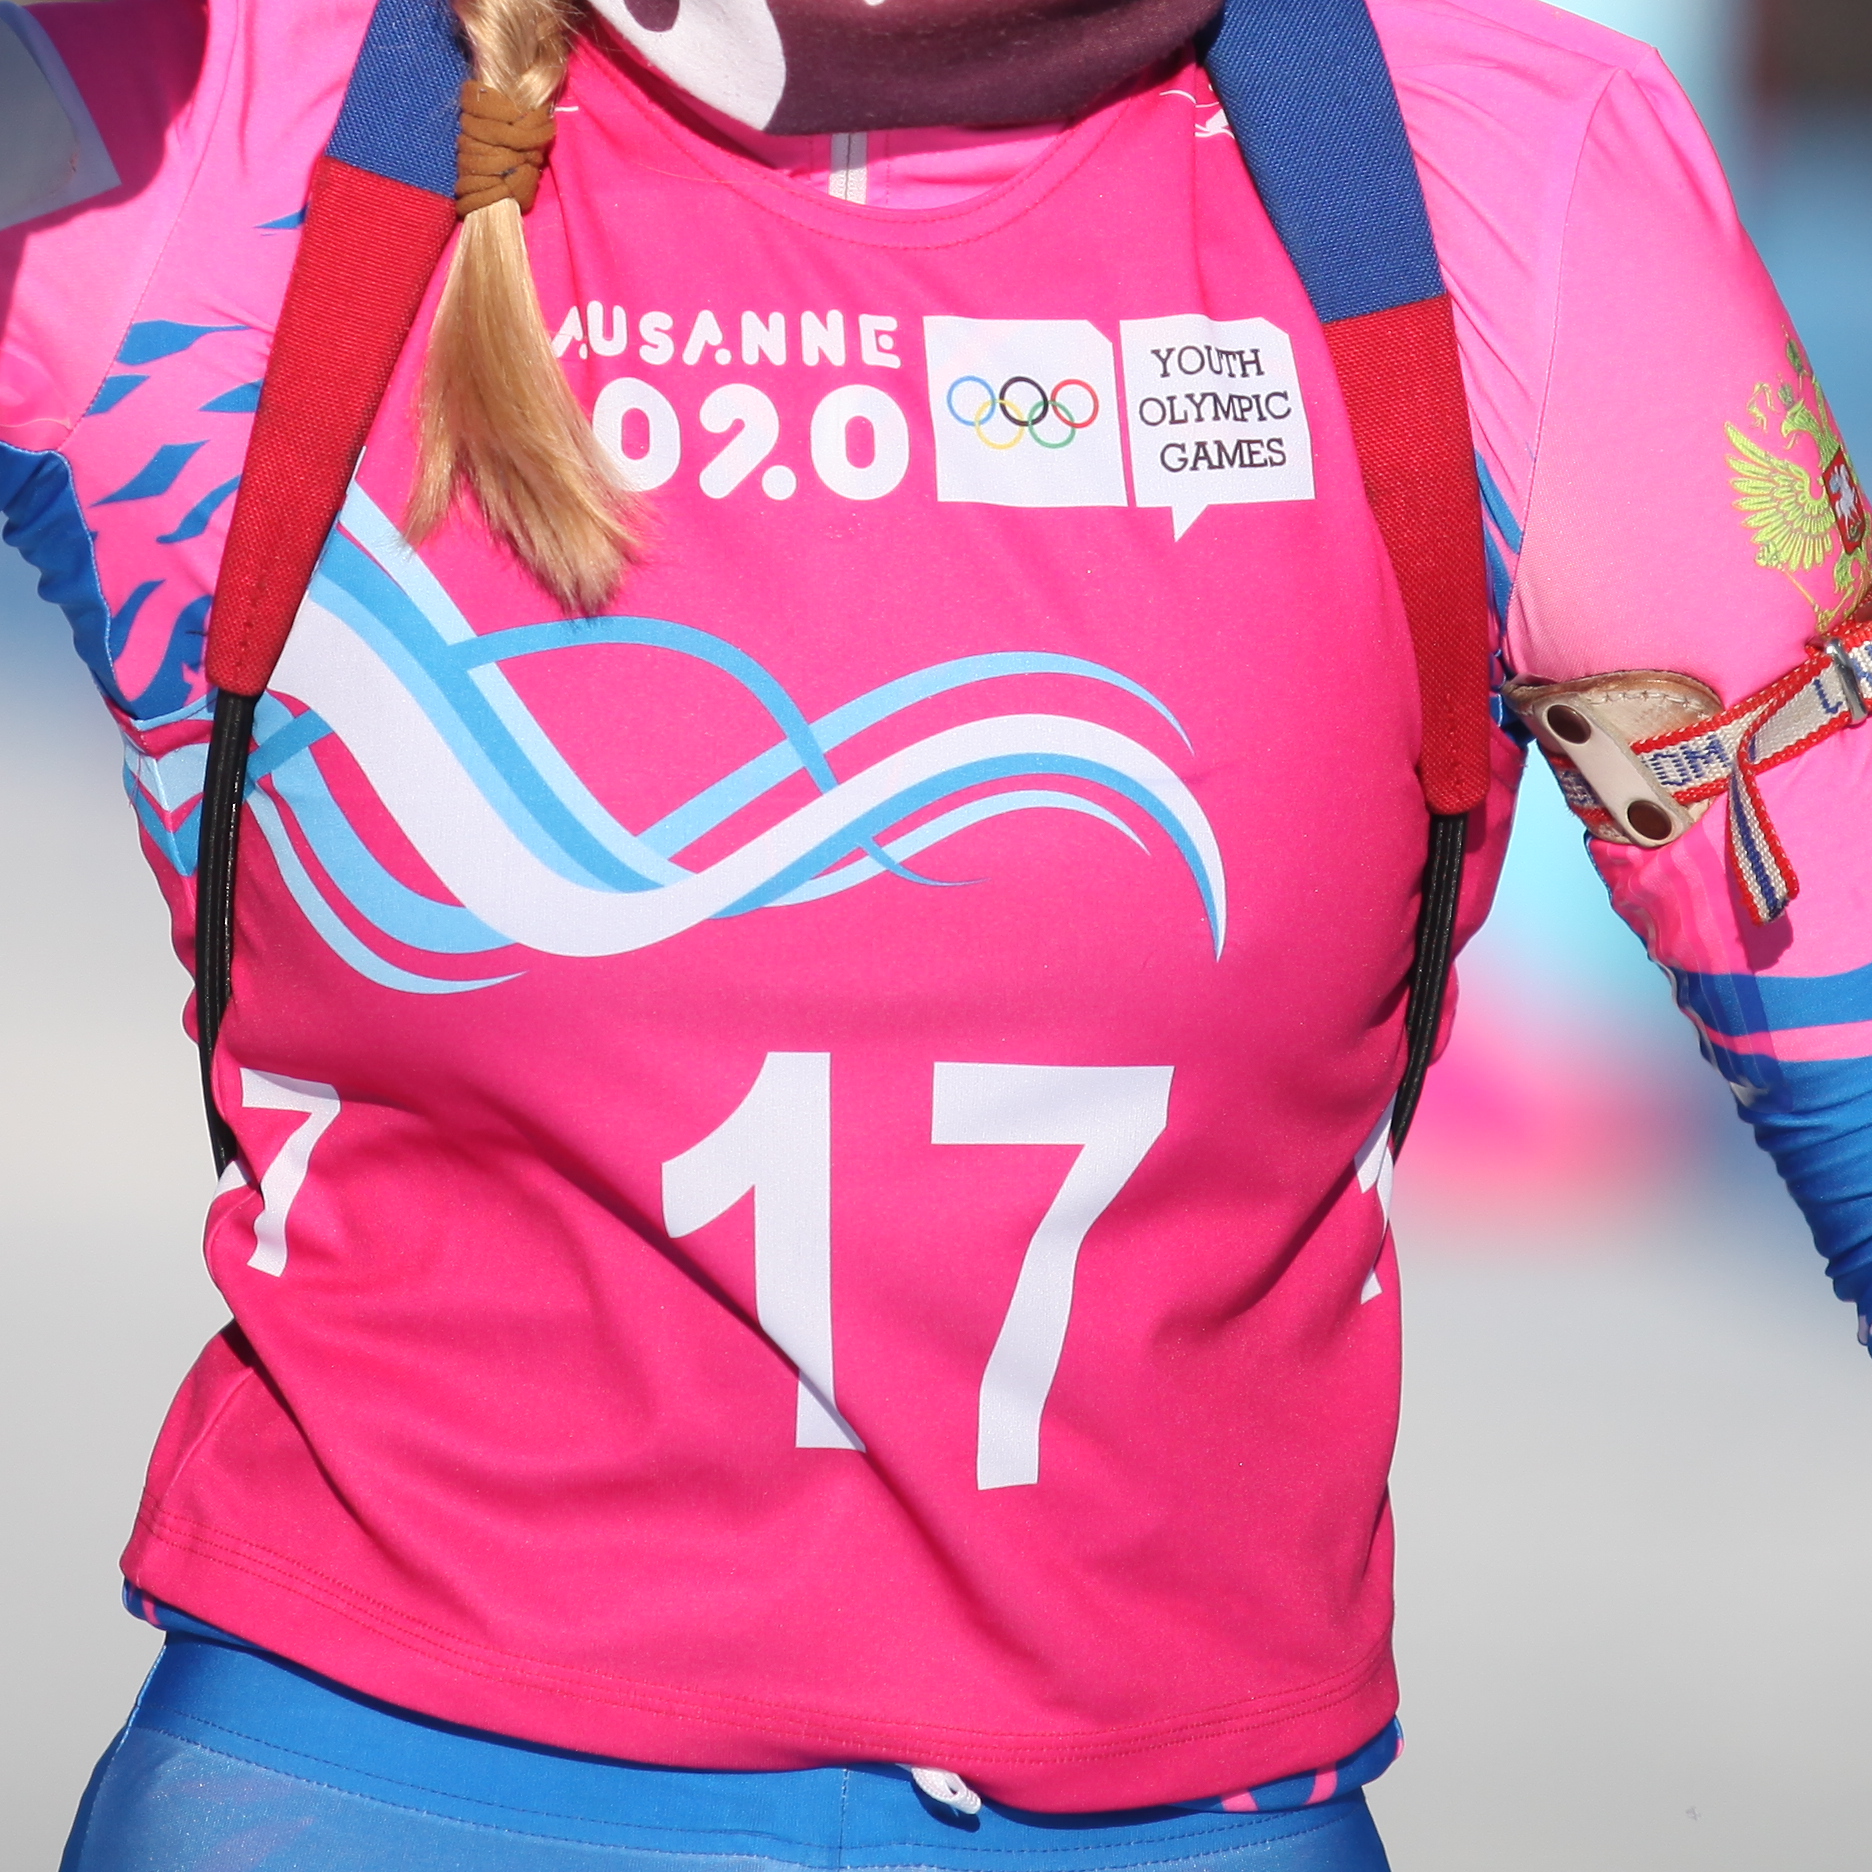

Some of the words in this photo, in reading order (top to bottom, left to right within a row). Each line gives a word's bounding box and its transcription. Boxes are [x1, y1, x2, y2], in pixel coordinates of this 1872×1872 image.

[550, 300, 901, 368] AUSANNE
[1150, 344, 1265, 378] YOUTH
[1139, 390, 1292, 426] OLYMPIC
[590, 376, 910, 502] 020
[1160, 437, 1287, 473] GAMES
[1640, 734, 1734, 786] OM
[213, 1066, 342, 1278] 7
[661, 1051, 1174, 1490] 17
